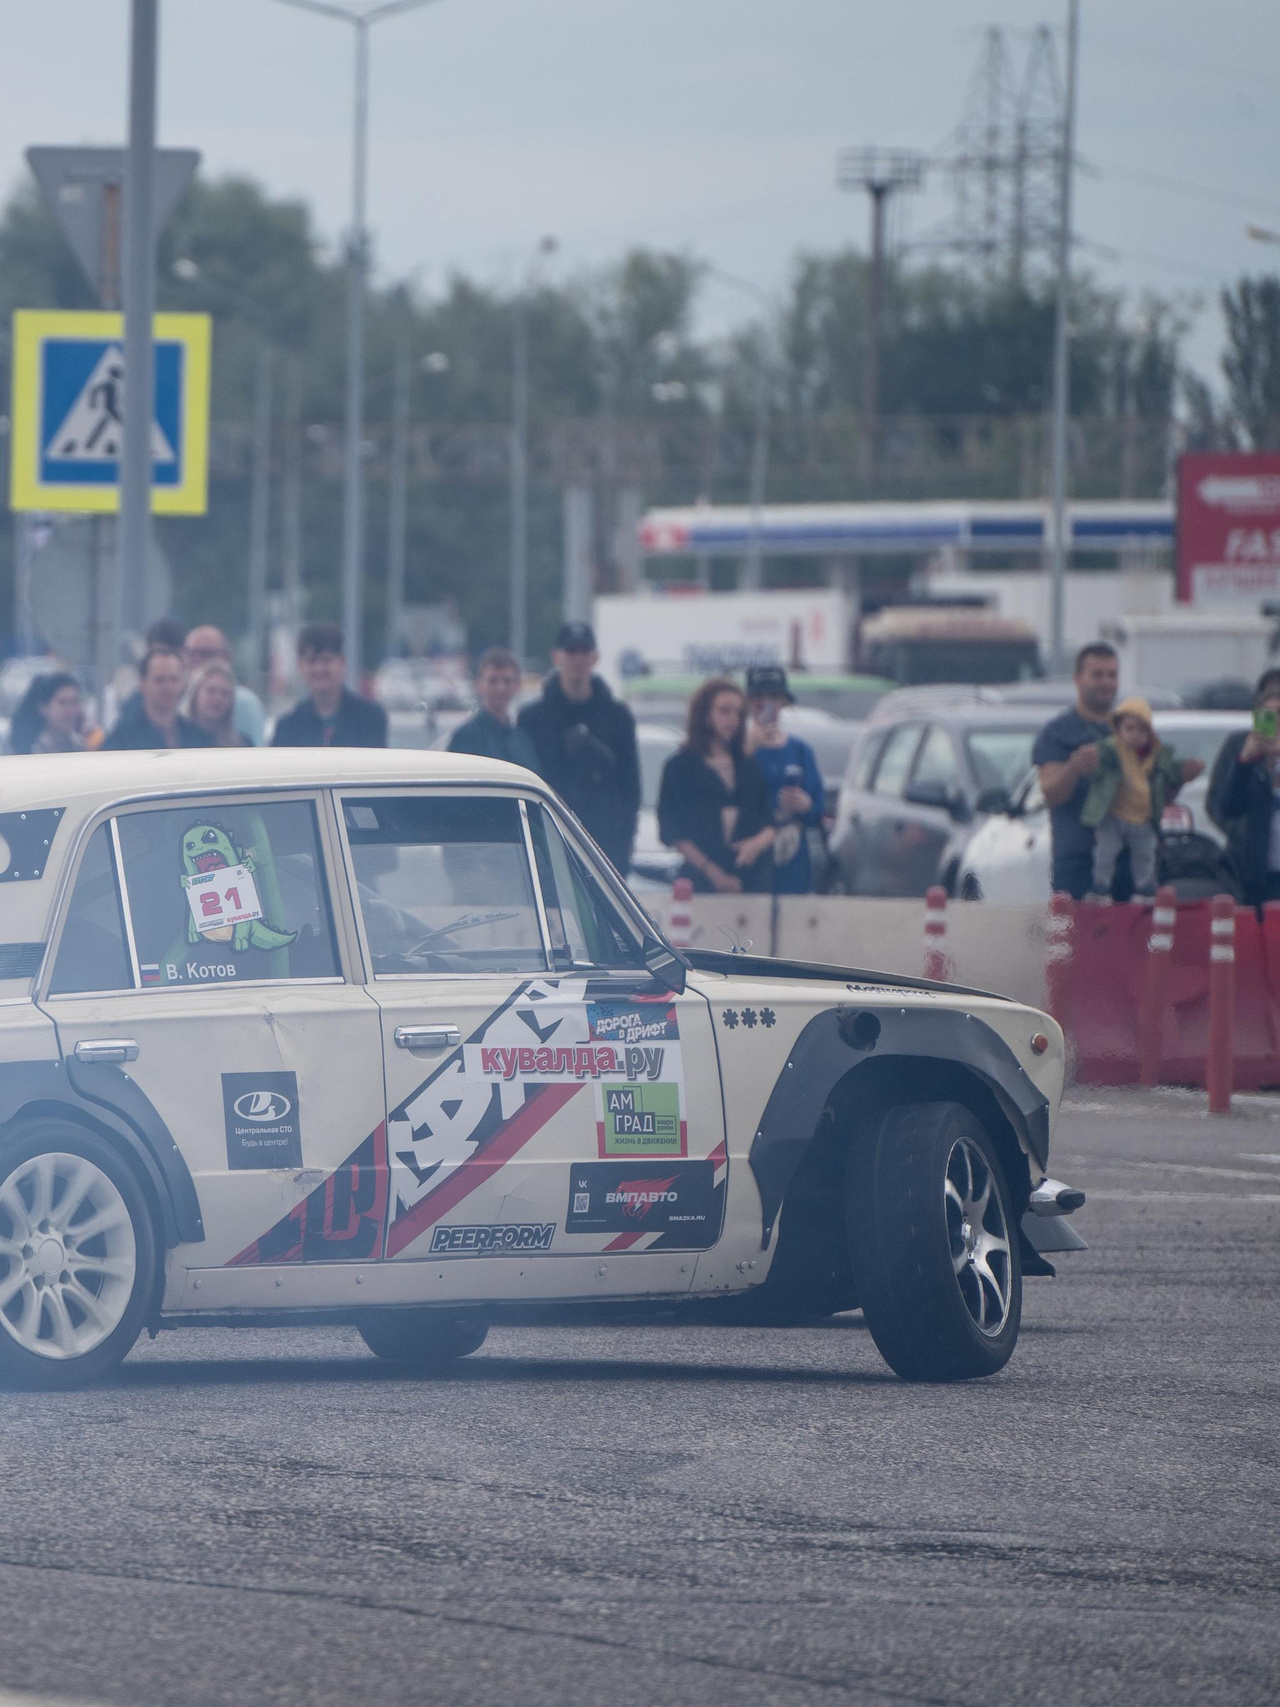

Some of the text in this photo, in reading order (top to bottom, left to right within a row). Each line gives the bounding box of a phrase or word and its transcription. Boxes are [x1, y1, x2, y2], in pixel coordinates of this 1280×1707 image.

[200, 886, 243, 917] 21
[166, 962, 236, 980] В. Котов
[596, 1013, 642, 1034] ДОРОГА
[626, 1020, 669, 1043] ДРИФТ
[480, 1045, 665, 1081] кувалда.ру
[610, 1092, 633, 1110] АМ
[235, 1127, 279, 1135] Центральная
[616, 1115, 654, 1132] ГРАД
[241, 1139, 258, 1148] Будь
[642, 1137, 677, 1145] ДВИЖЕНИИ
[605, 1192, 678, 1203] ВМПАВТО
[431, 1225, 556, 1251] PEERFORM
